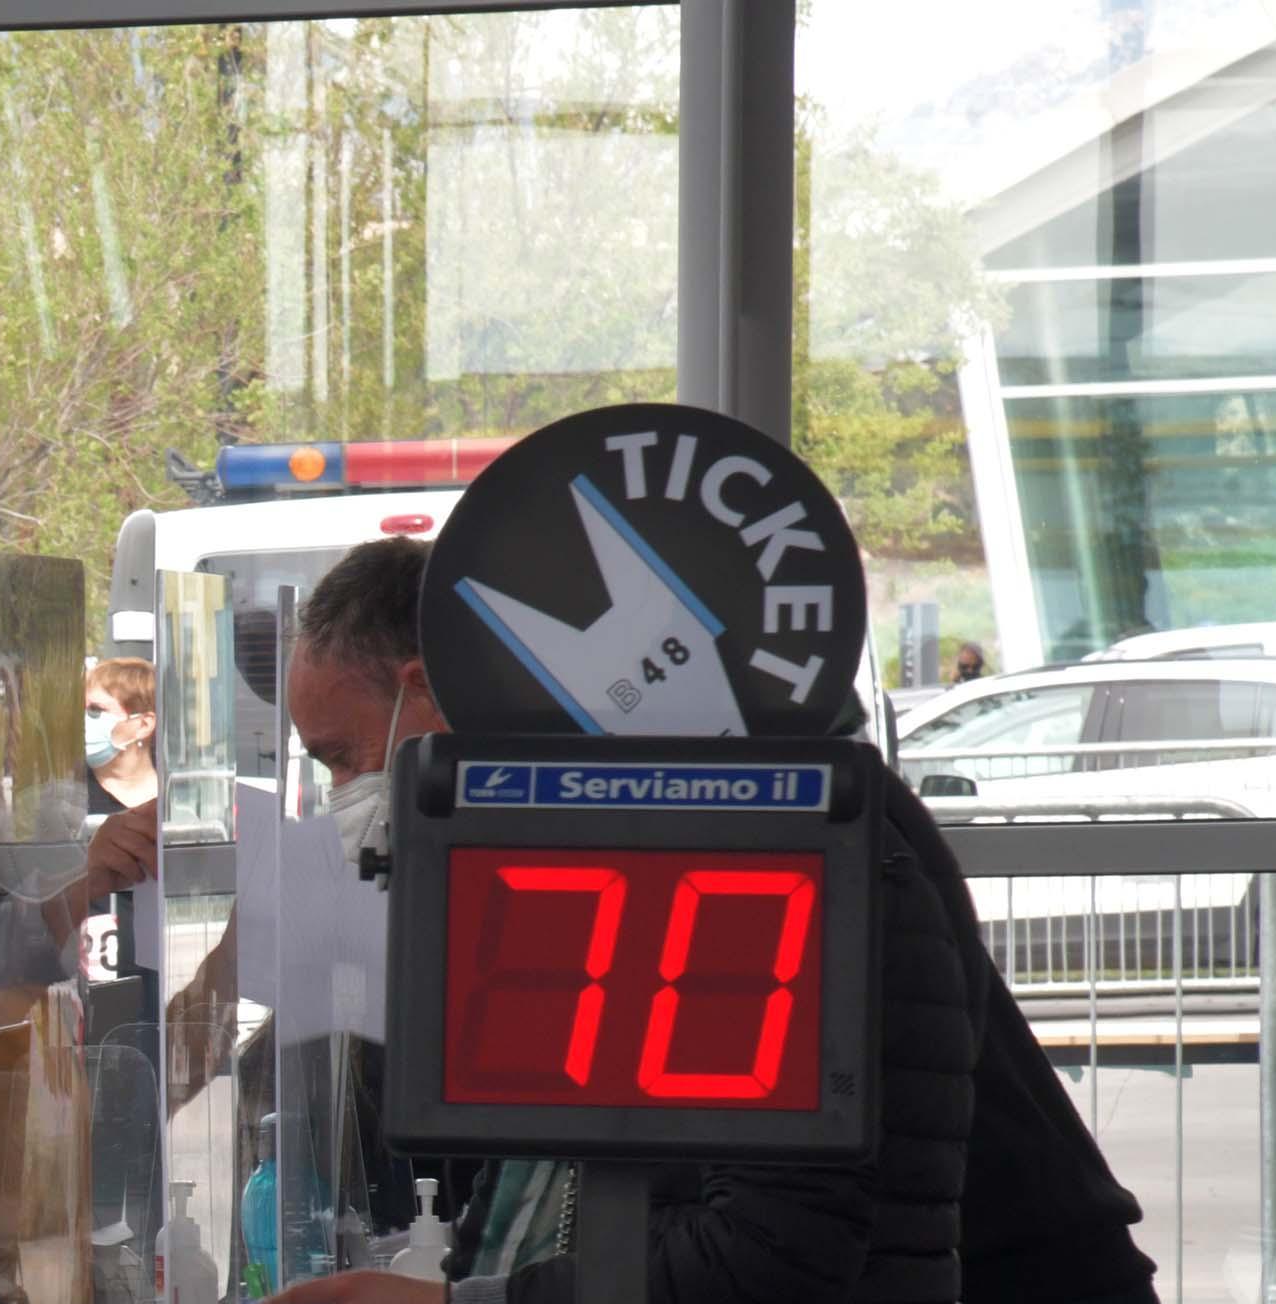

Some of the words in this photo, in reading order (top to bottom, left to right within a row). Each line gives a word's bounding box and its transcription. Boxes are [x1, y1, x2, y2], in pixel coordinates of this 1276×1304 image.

[605, 431, 833, 704] TICKET
[559, 771, 758, 801] Serviamo
[772, 772, 798, 801] il
[496, 866, 816, 1098] 70
